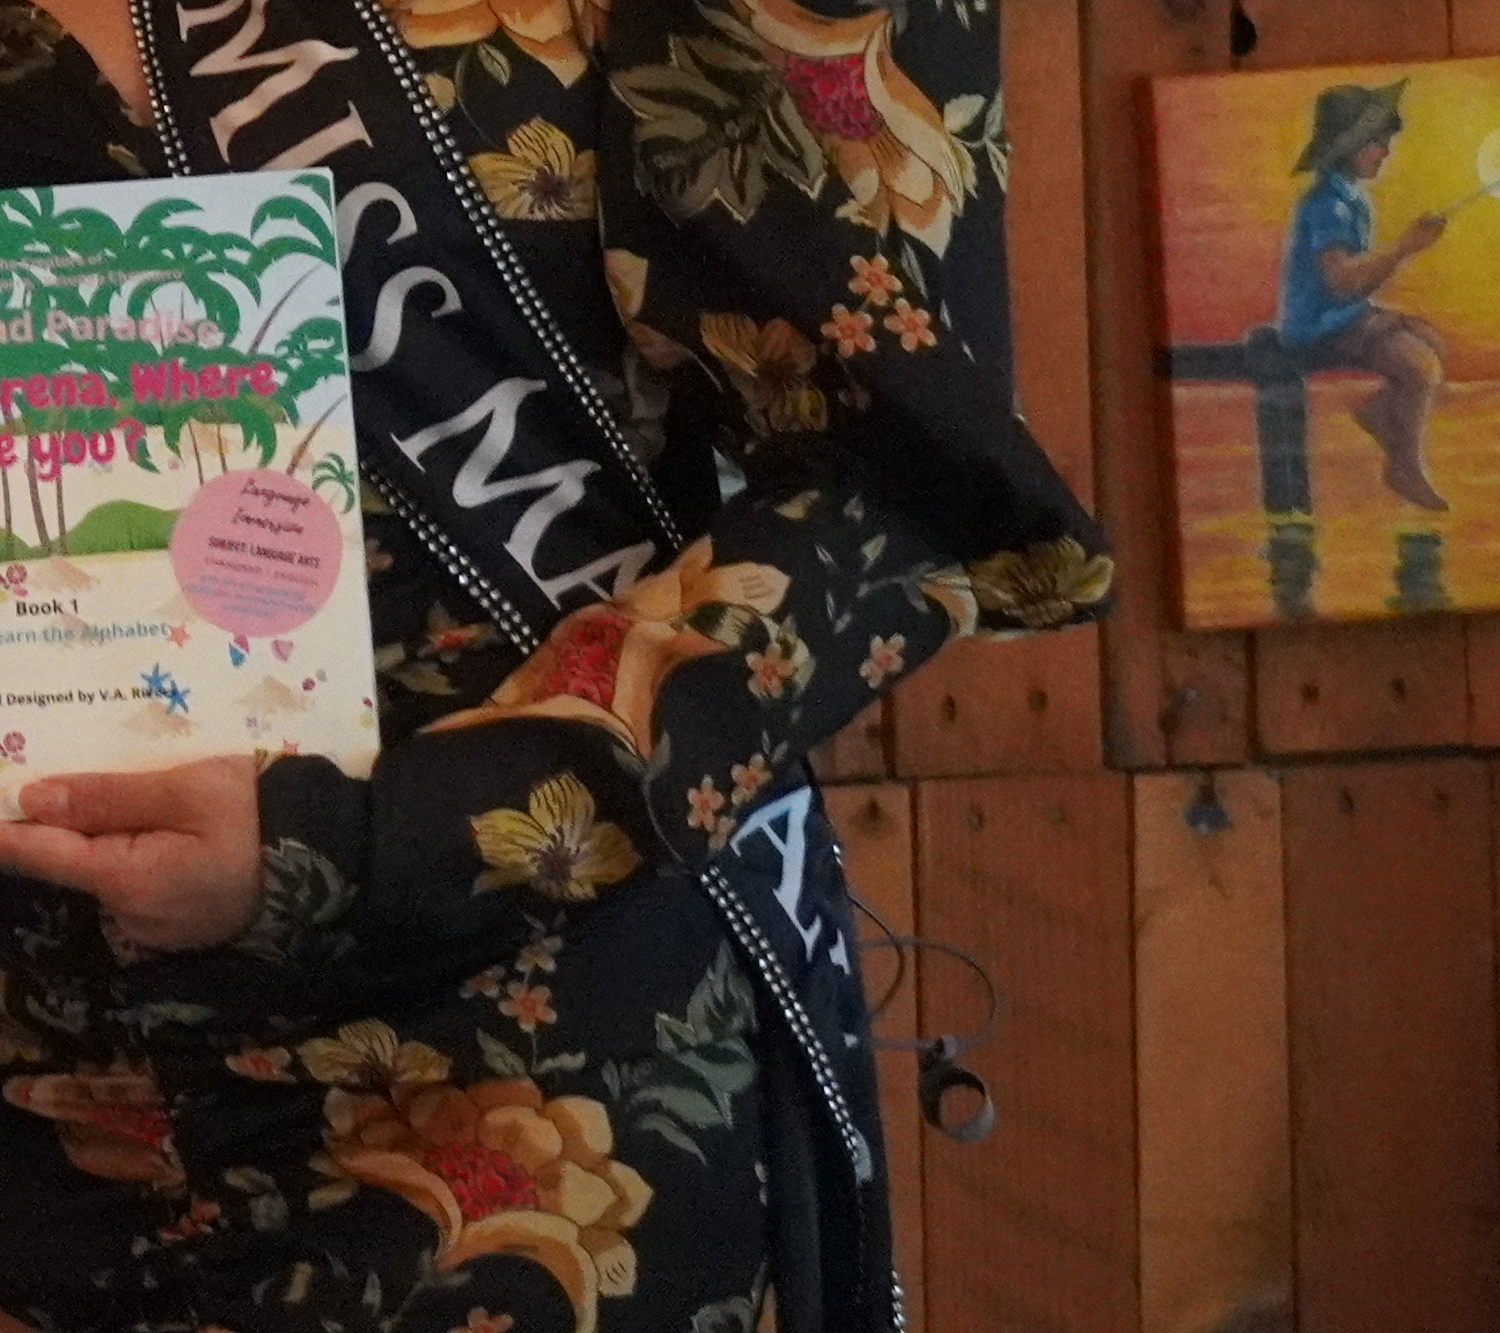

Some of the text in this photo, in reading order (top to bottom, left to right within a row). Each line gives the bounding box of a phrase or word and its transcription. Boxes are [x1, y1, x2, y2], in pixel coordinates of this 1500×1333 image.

[46, 308, 222, 349] Paradise
[129, 359, 277, 403] Where
[30, 417, 146, 483] you?
[15, 598, 79, 617] Book 1
[41, 627, 75, 642] the
[81, 622, 168, 645] Alphabet
[6, 689, 74, 708] Designed
[79, 687, 96, 703] by
